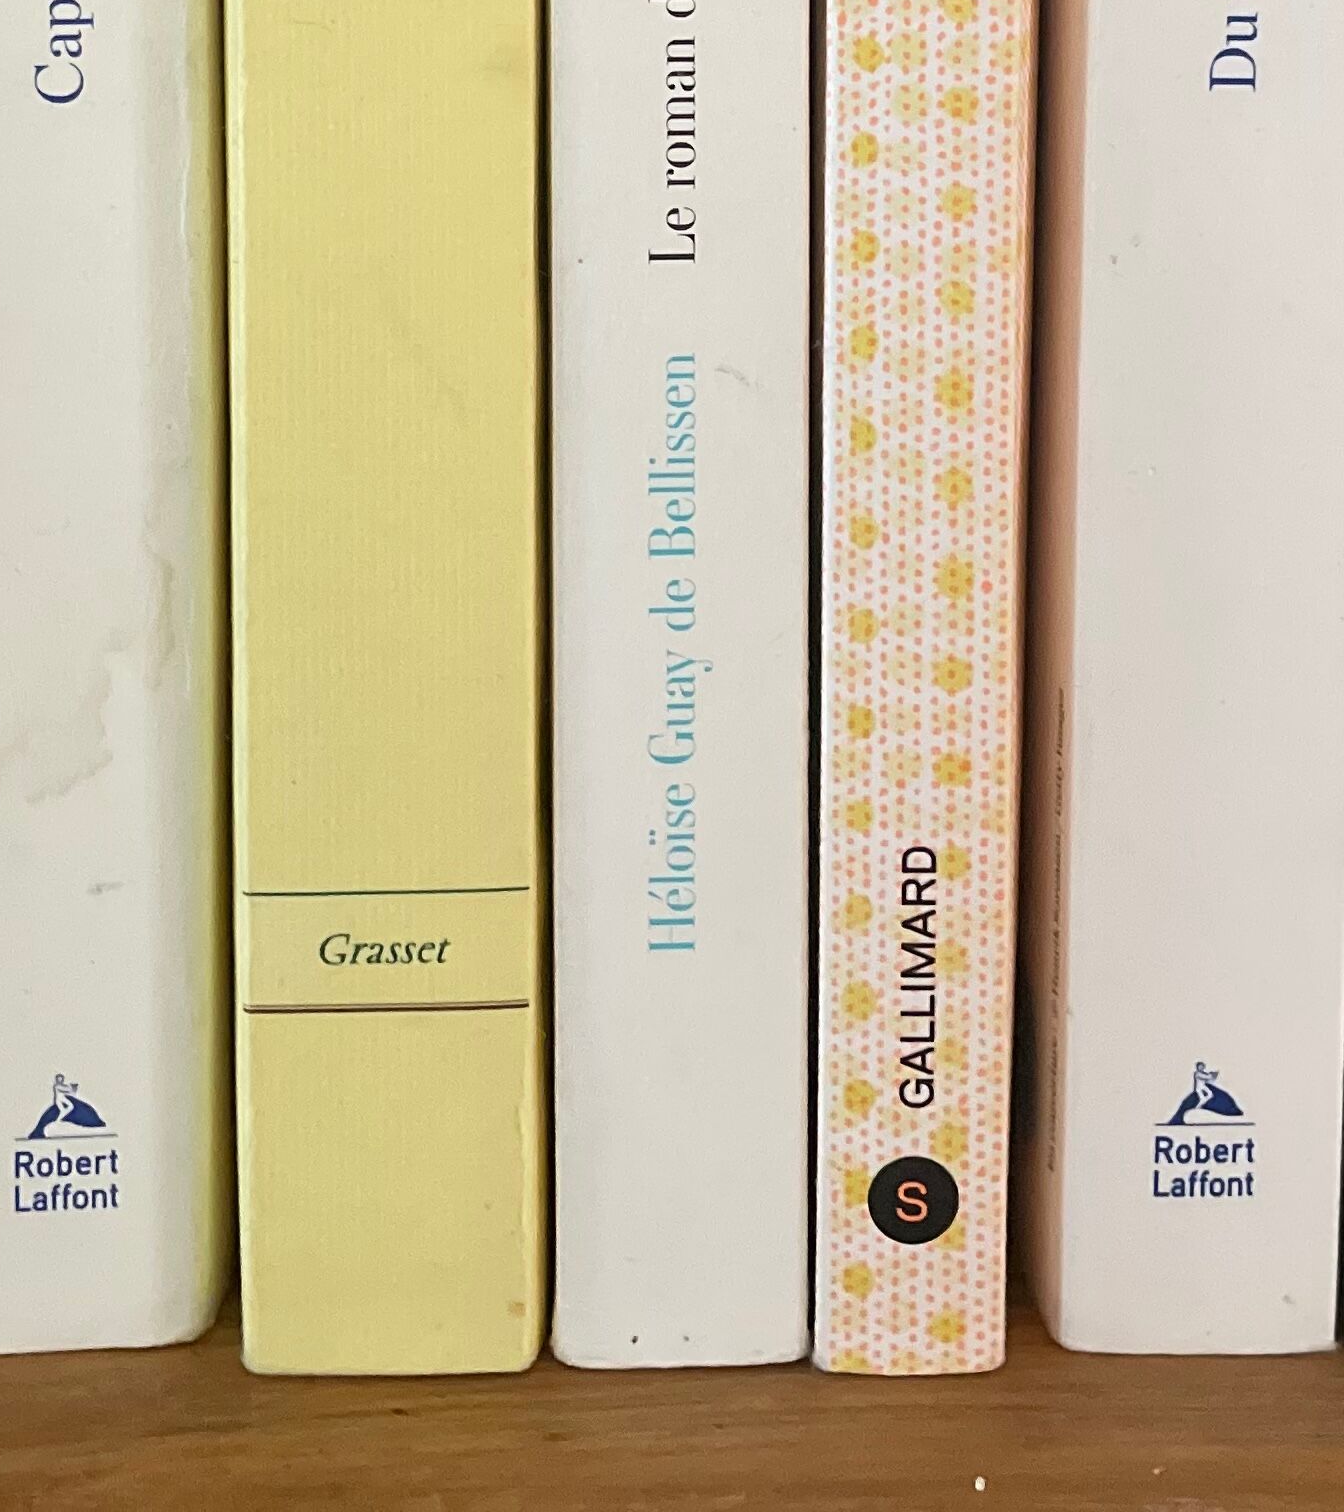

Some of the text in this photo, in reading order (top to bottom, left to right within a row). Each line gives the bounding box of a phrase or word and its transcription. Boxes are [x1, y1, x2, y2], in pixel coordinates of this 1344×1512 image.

[1207, 11, 1259, 93] Du
[664, 35, 698, 189] roman
[646, 205, 698, 265] Le
[646, 352, 714, 952] Héloïse Guay de Bellissen
[318, 932, 452, 967] Grasset
[897, 845, 938, 1110] GALLIMARD
[13, 1147, 120, 1180] Robert
[1153, 1134, 1256, 1166] Robert
[13, 1181, 120, 1214] Laffont
[1152, 1168, 1256, 1199] Laffont
